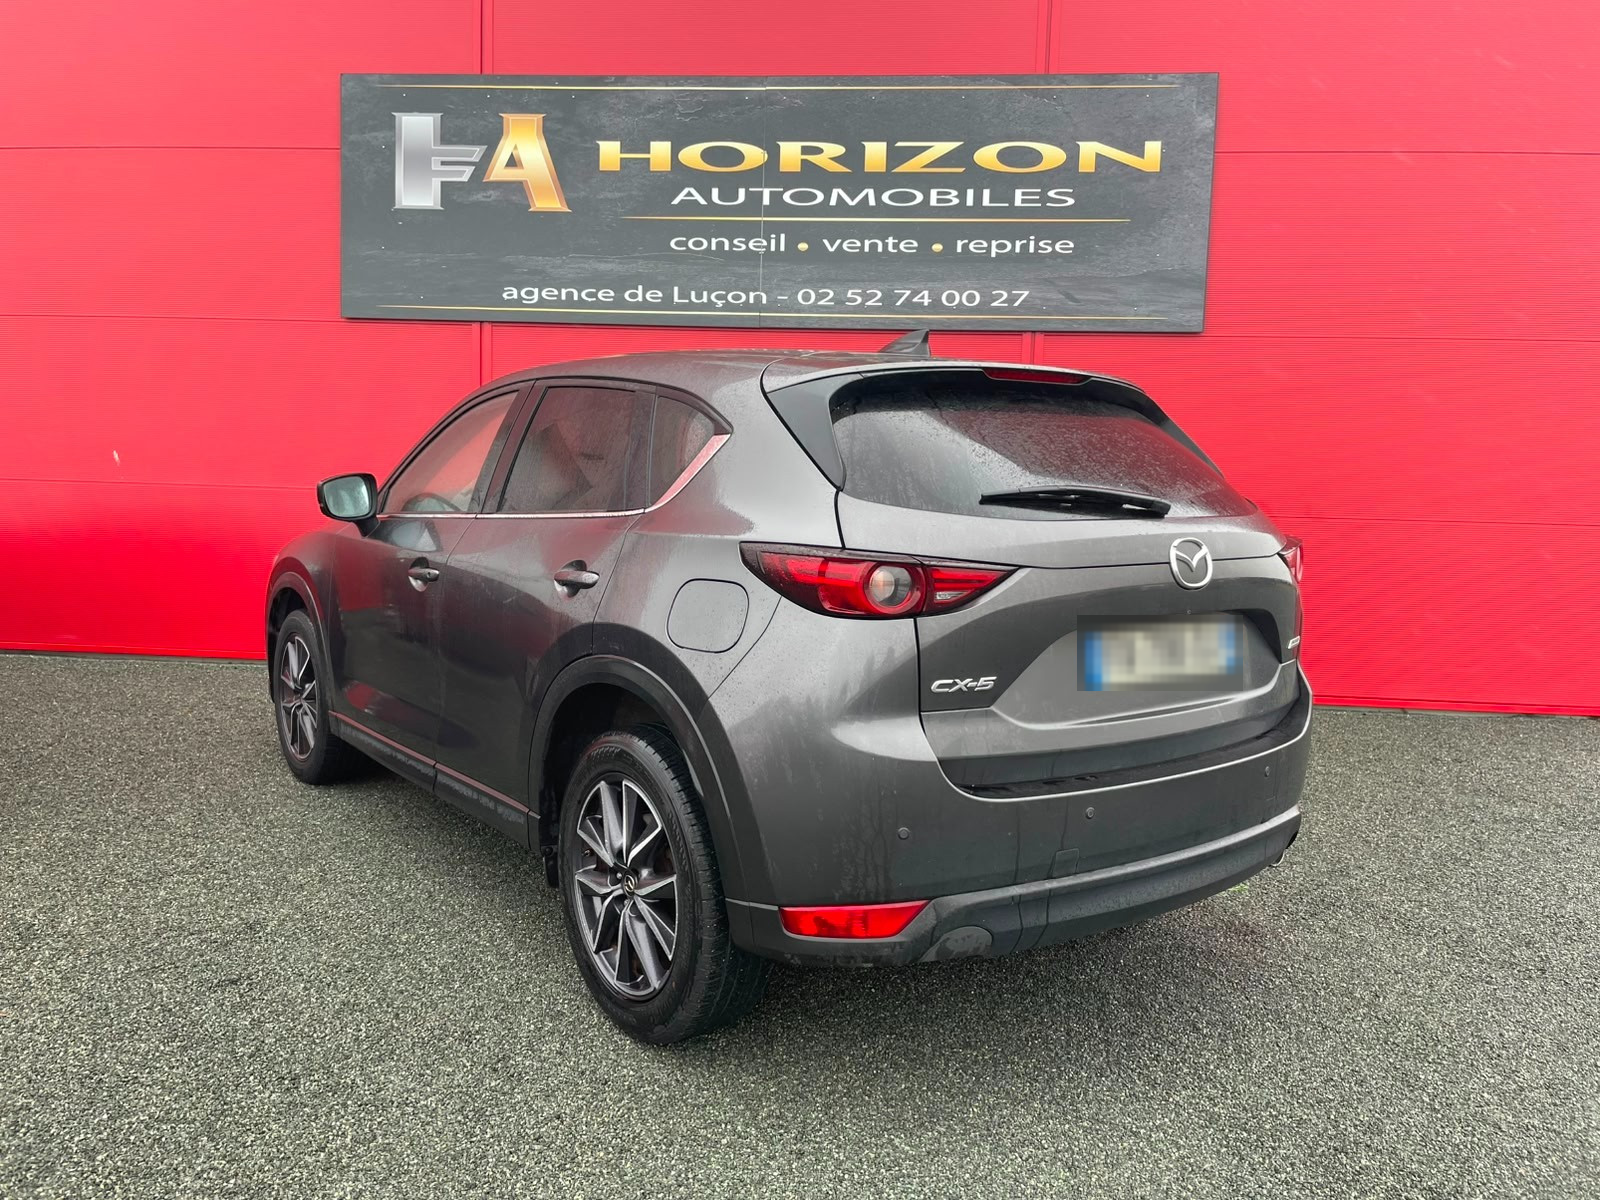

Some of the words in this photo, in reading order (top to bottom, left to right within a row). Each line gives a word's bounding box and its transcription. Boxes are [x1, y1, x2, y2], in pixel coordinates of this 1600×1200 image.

[596, 140, 1163, 173] HORIZON
[671, 187, 1076, 208] AUTOMOBILES
[669, 231, 786, 252] conseil
[822, 236, 919, 253] vente
[956, 235, 1076, 258] reprise
[501, 286, 616, 304] agence
[623, 285, 664, 302] de
[673, 286, 768, 307] Luçon
[797, 288, 836, 306] 02
[845, 289, 883, 306] 52
[894, 289, 933, 307] 74
[940, 289, 981, 307] 00
[990, 289, 1031, 307] 27
[930, 676, 998, 694] CX-5
